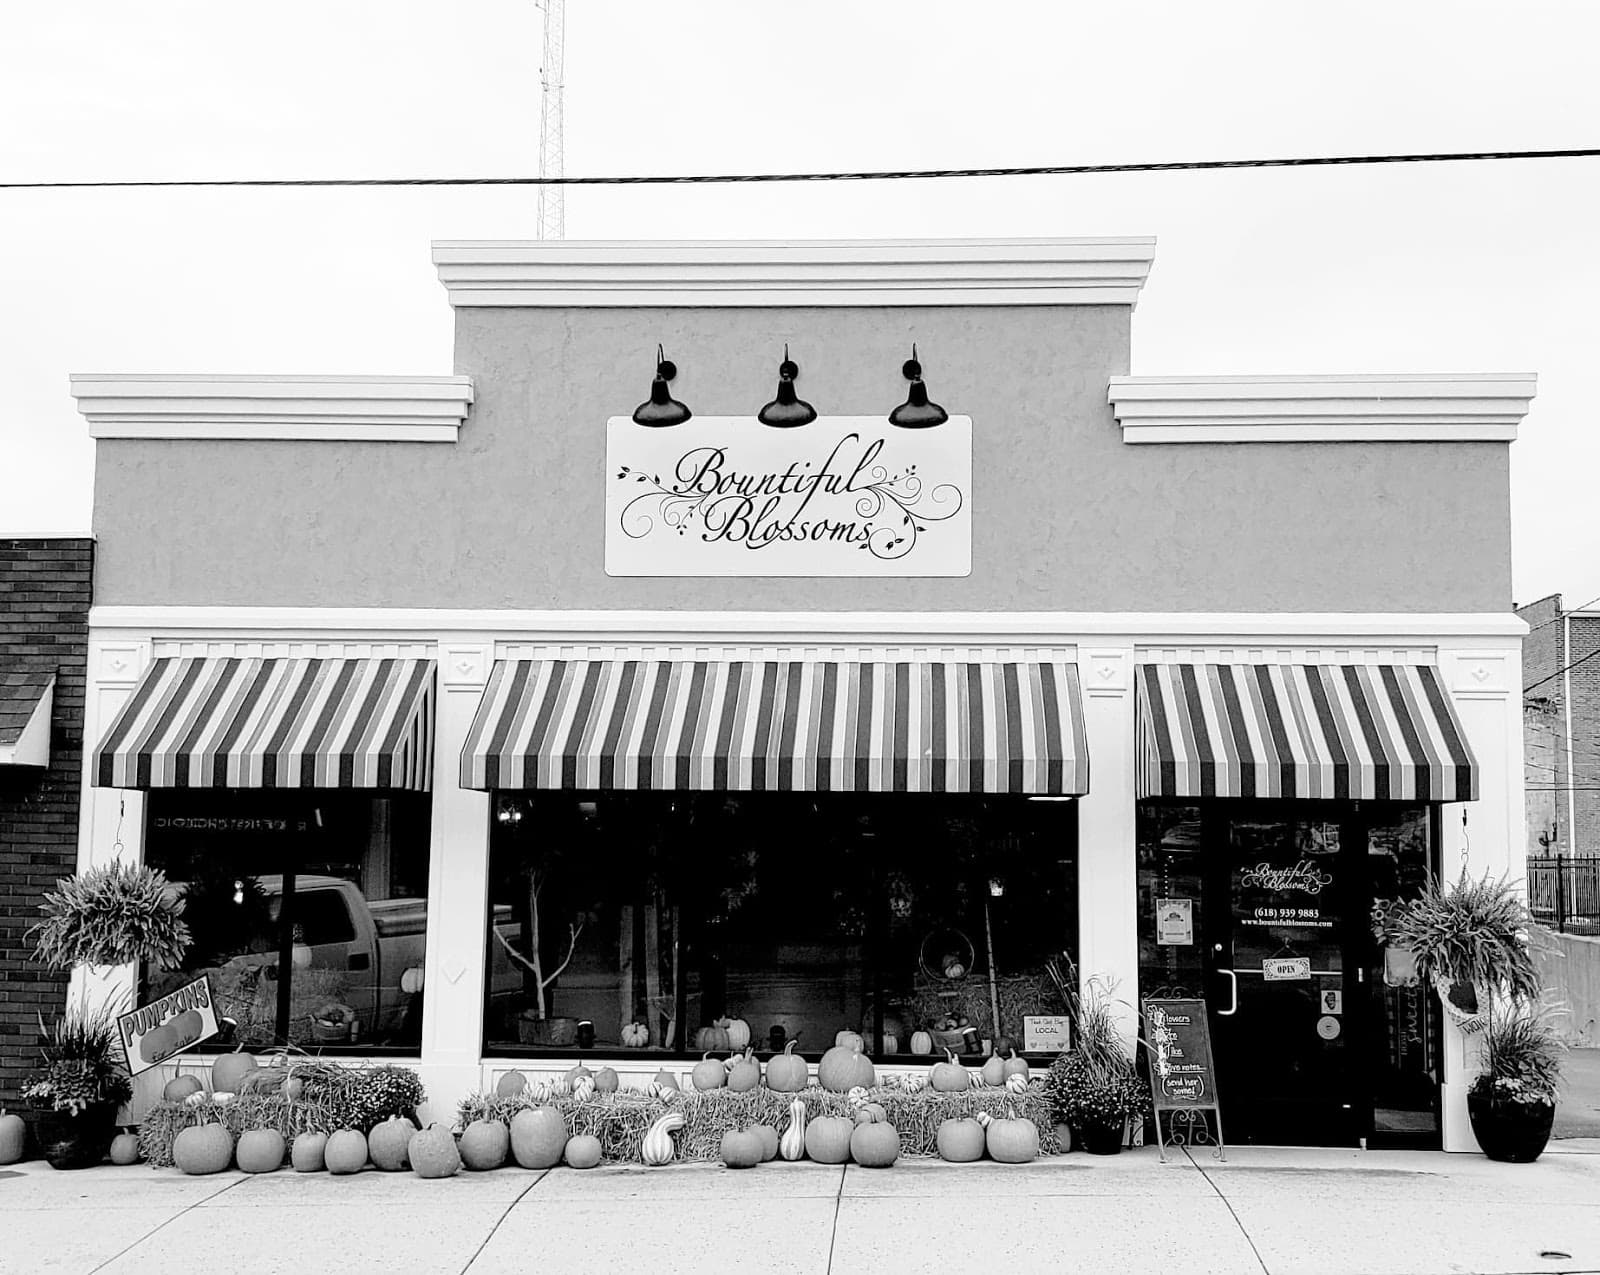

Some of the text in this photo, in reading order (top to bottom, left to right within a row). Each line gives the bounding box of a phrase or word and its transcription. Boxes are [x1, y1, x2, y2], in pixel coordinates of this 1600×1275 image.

[673, 433, 885, 517] Bountiful
[702, 495, 873, 549] Blossoms
[1255, 859, 1314, 882] Bountiful
[1263, 875, 1309, 891] Blossoms
[1254, 907, 1320, 919] (618) 939 9883
[1277, 965, 1296, 974] OPEN
[123, 981, 208, 1047] PUMPKINS
[1035, 1026, 1059, 1034] LOCAL
